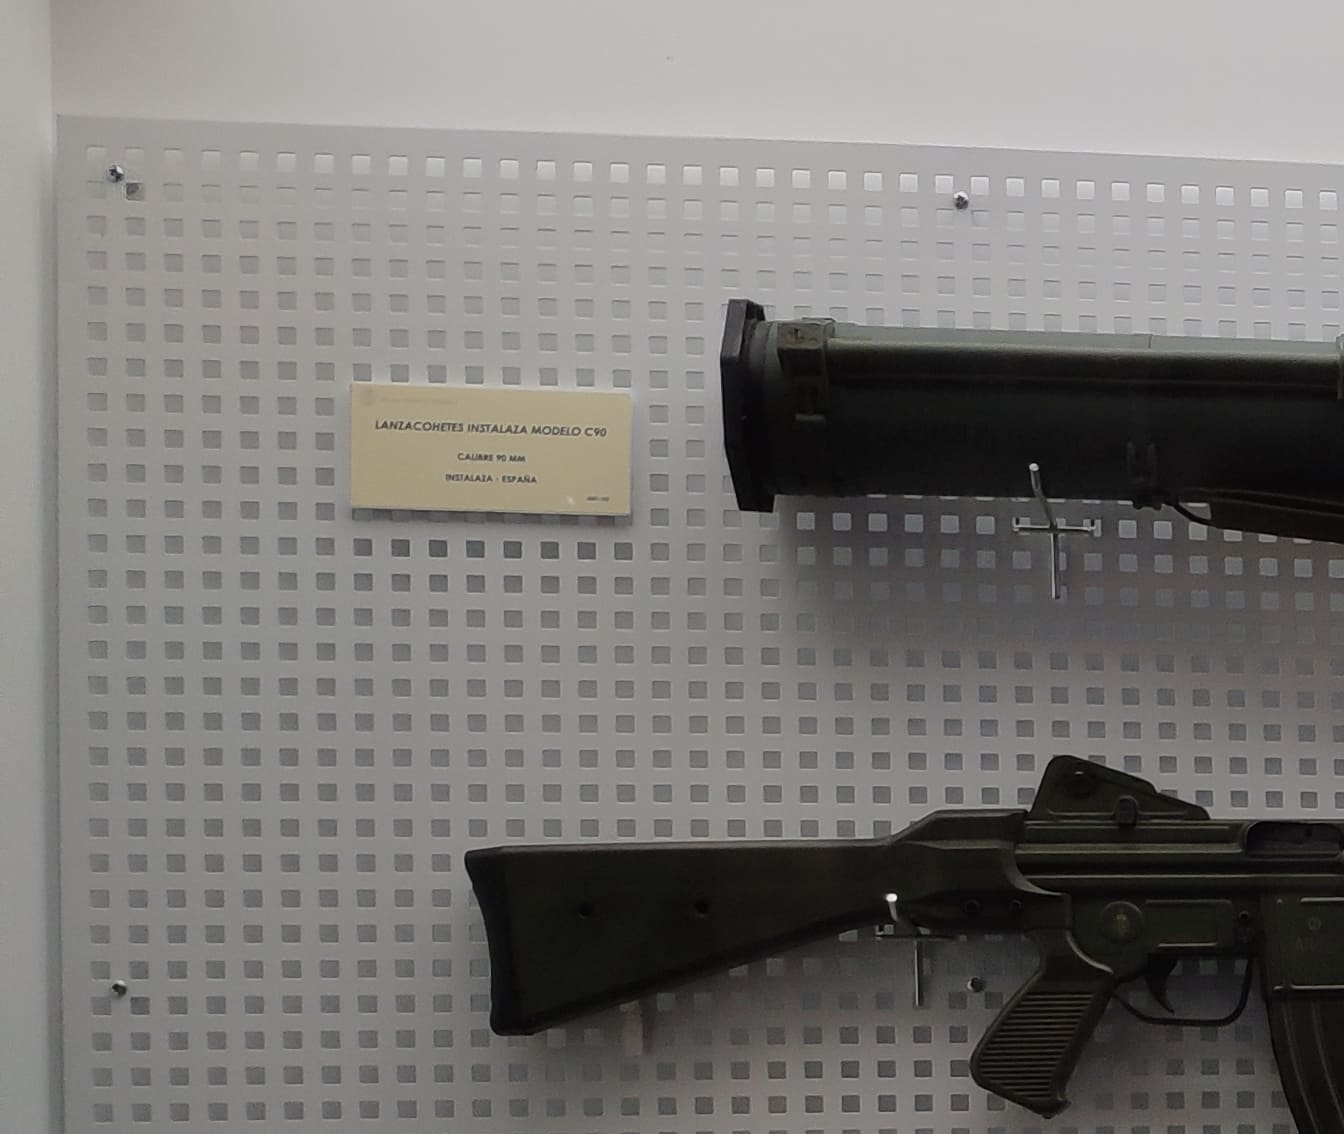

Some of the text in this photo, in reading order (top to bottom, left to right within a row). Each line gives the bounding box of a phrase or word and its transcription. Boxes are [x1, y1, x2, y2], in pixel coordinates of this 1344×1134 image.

[375, 420, 608, 438] LANZACOHETES INSTALAZA MODELO C90
[457, 452, 526, 463] CALIBRE 90 MM
[501, 473, 537, 484] ESPAÑA
